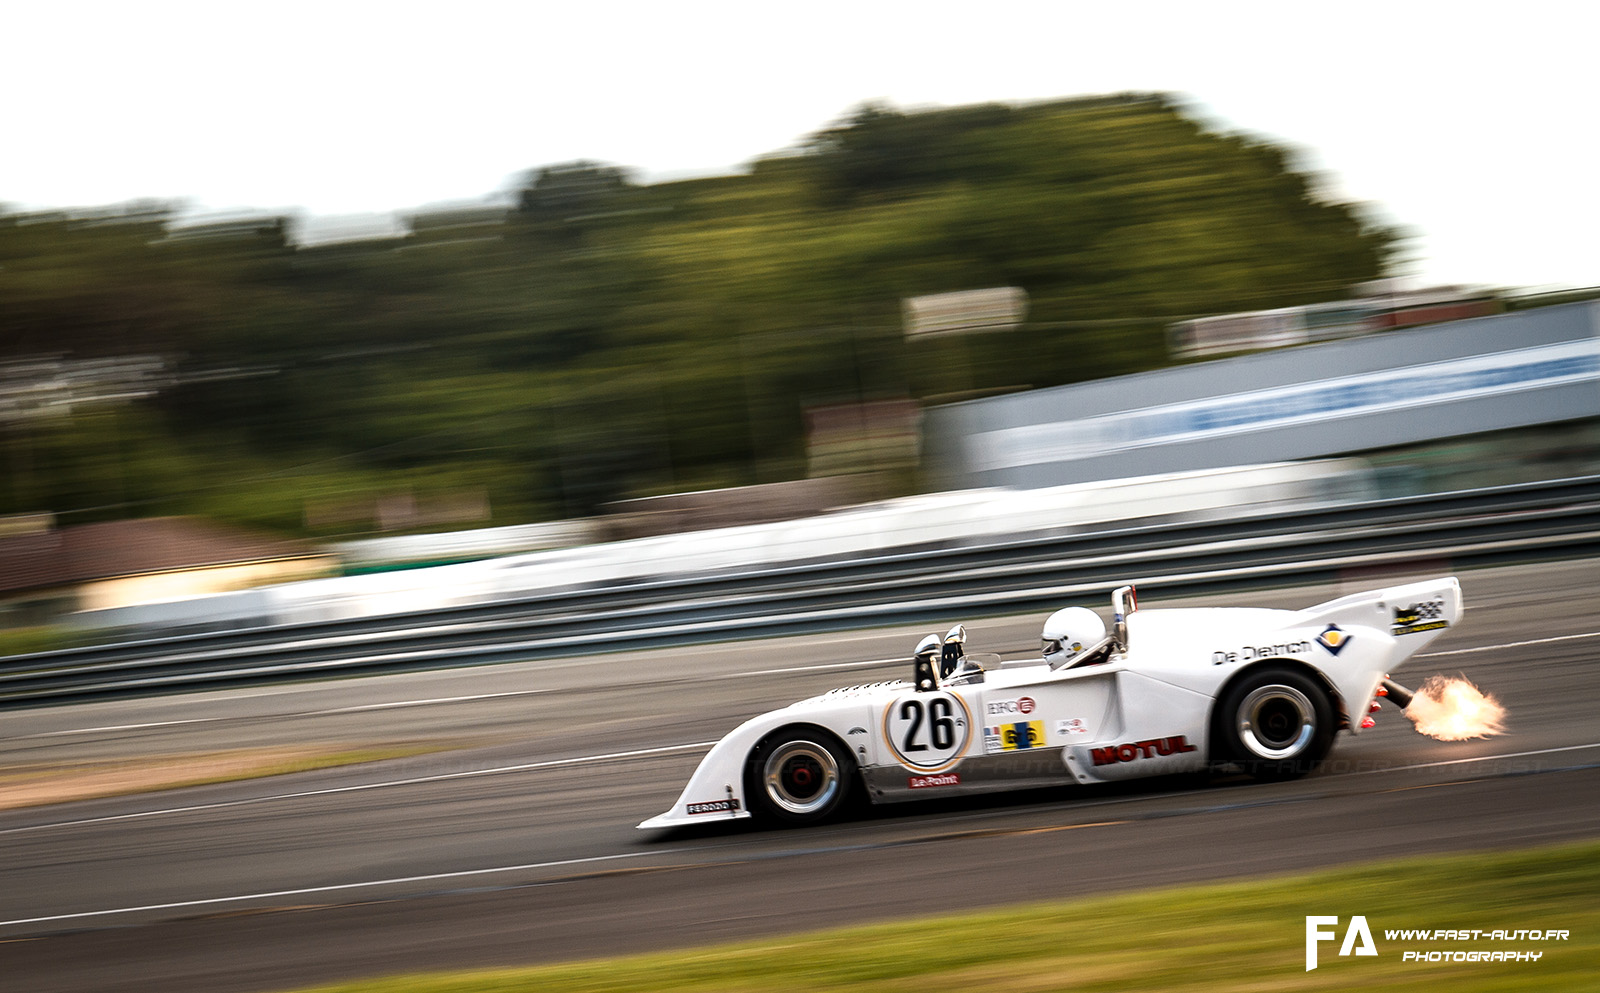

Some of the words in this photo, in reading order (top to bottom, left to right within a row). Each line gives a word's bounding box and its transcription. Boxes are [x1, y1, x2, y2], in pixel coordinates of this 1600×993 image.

[1212, 651, 1238, 665] De
[900, 698, 955, 752] 26
[1089, 735, 1198, 766] MOTUL
[911, 778, 926, 787] Le
[926, 775, 958, 786] Point
[688, 802, 730, 814] FERODO
